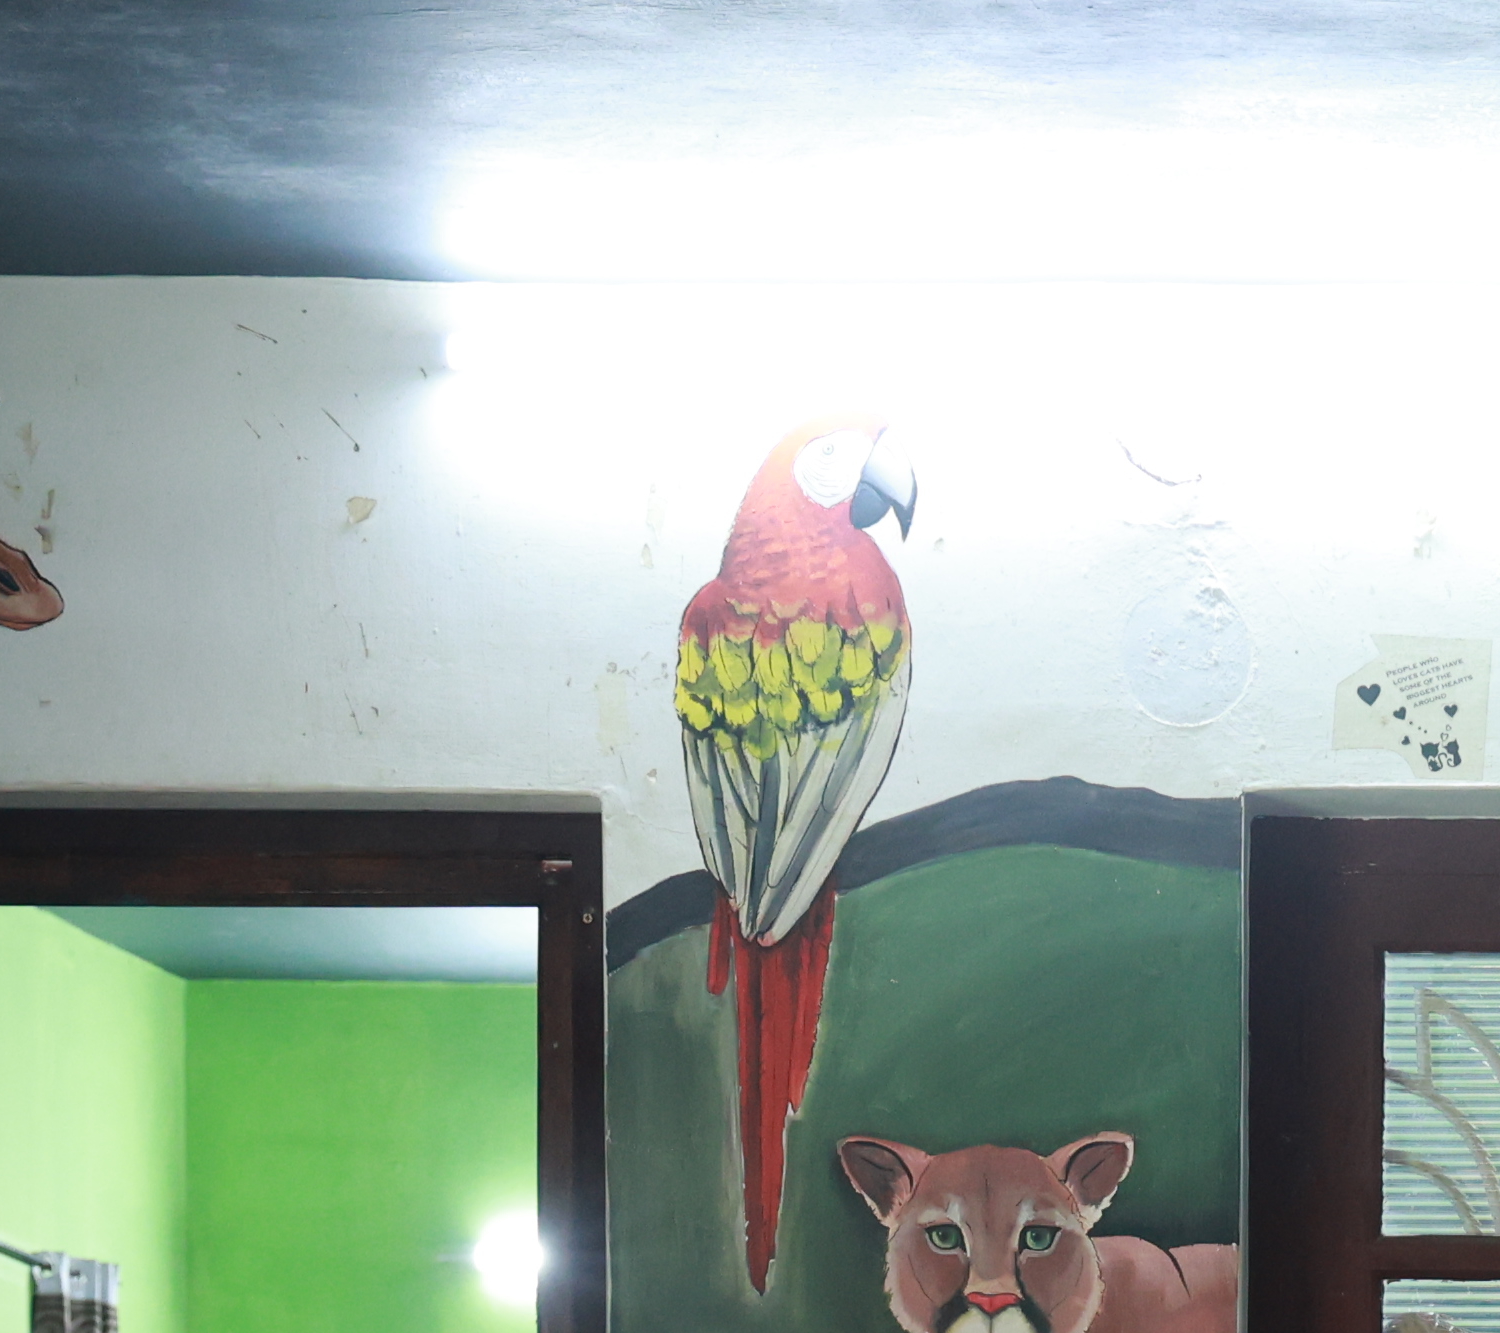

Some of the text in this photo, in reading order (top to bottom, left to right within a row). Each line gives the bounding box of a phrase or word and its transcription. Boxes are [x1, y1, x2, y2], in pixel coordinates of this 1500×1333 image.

[1385, 656, 1439, 678] PEOPLE WHO
[1392, 658, 1464, 686] LOVES CATS HAVE
[1399, 671, 1452, 693] SOME OF THE
[1406, 674, 1473, 701] BIGGEST HEARTS
[1413, 692, 1447, 708] AROUND
